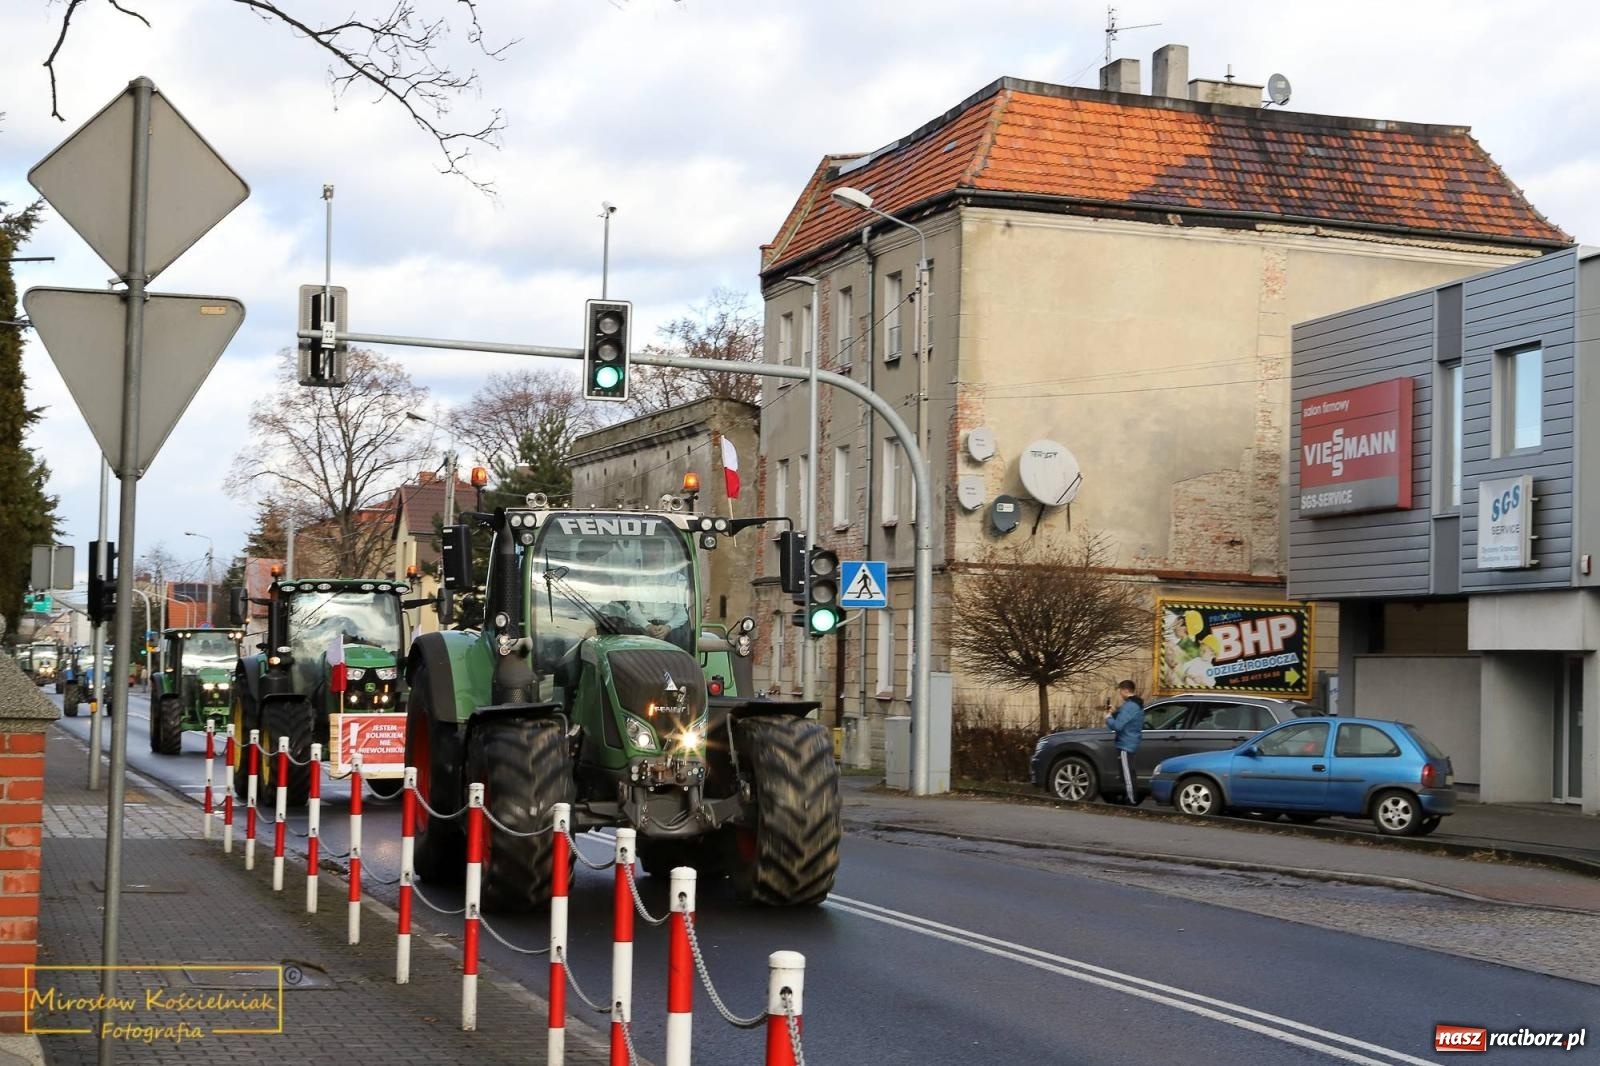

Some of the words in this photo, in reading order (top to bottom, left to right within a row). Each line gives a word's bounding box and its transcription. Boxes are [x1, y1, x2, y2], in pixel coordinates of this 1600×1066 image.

[1303, 405, 1321, 417] salon
[1322, 400, 1350, 414] firmowy
[1303, 428, 1396, 477] VIESSMANN
[1301, 490, 1353, 510] SGS-SERVICE
[1491, 484, 1520, 521] SGS
[557, 518, 662, 536] FENDT
[1491, 524, 1520, 535] SERVICE
[1212, 616, 1297, 662] BHP
[1206, 660, 1245, 677] ODZIEŻ
[1247, 654, 1297, 670] ROBOCZA
